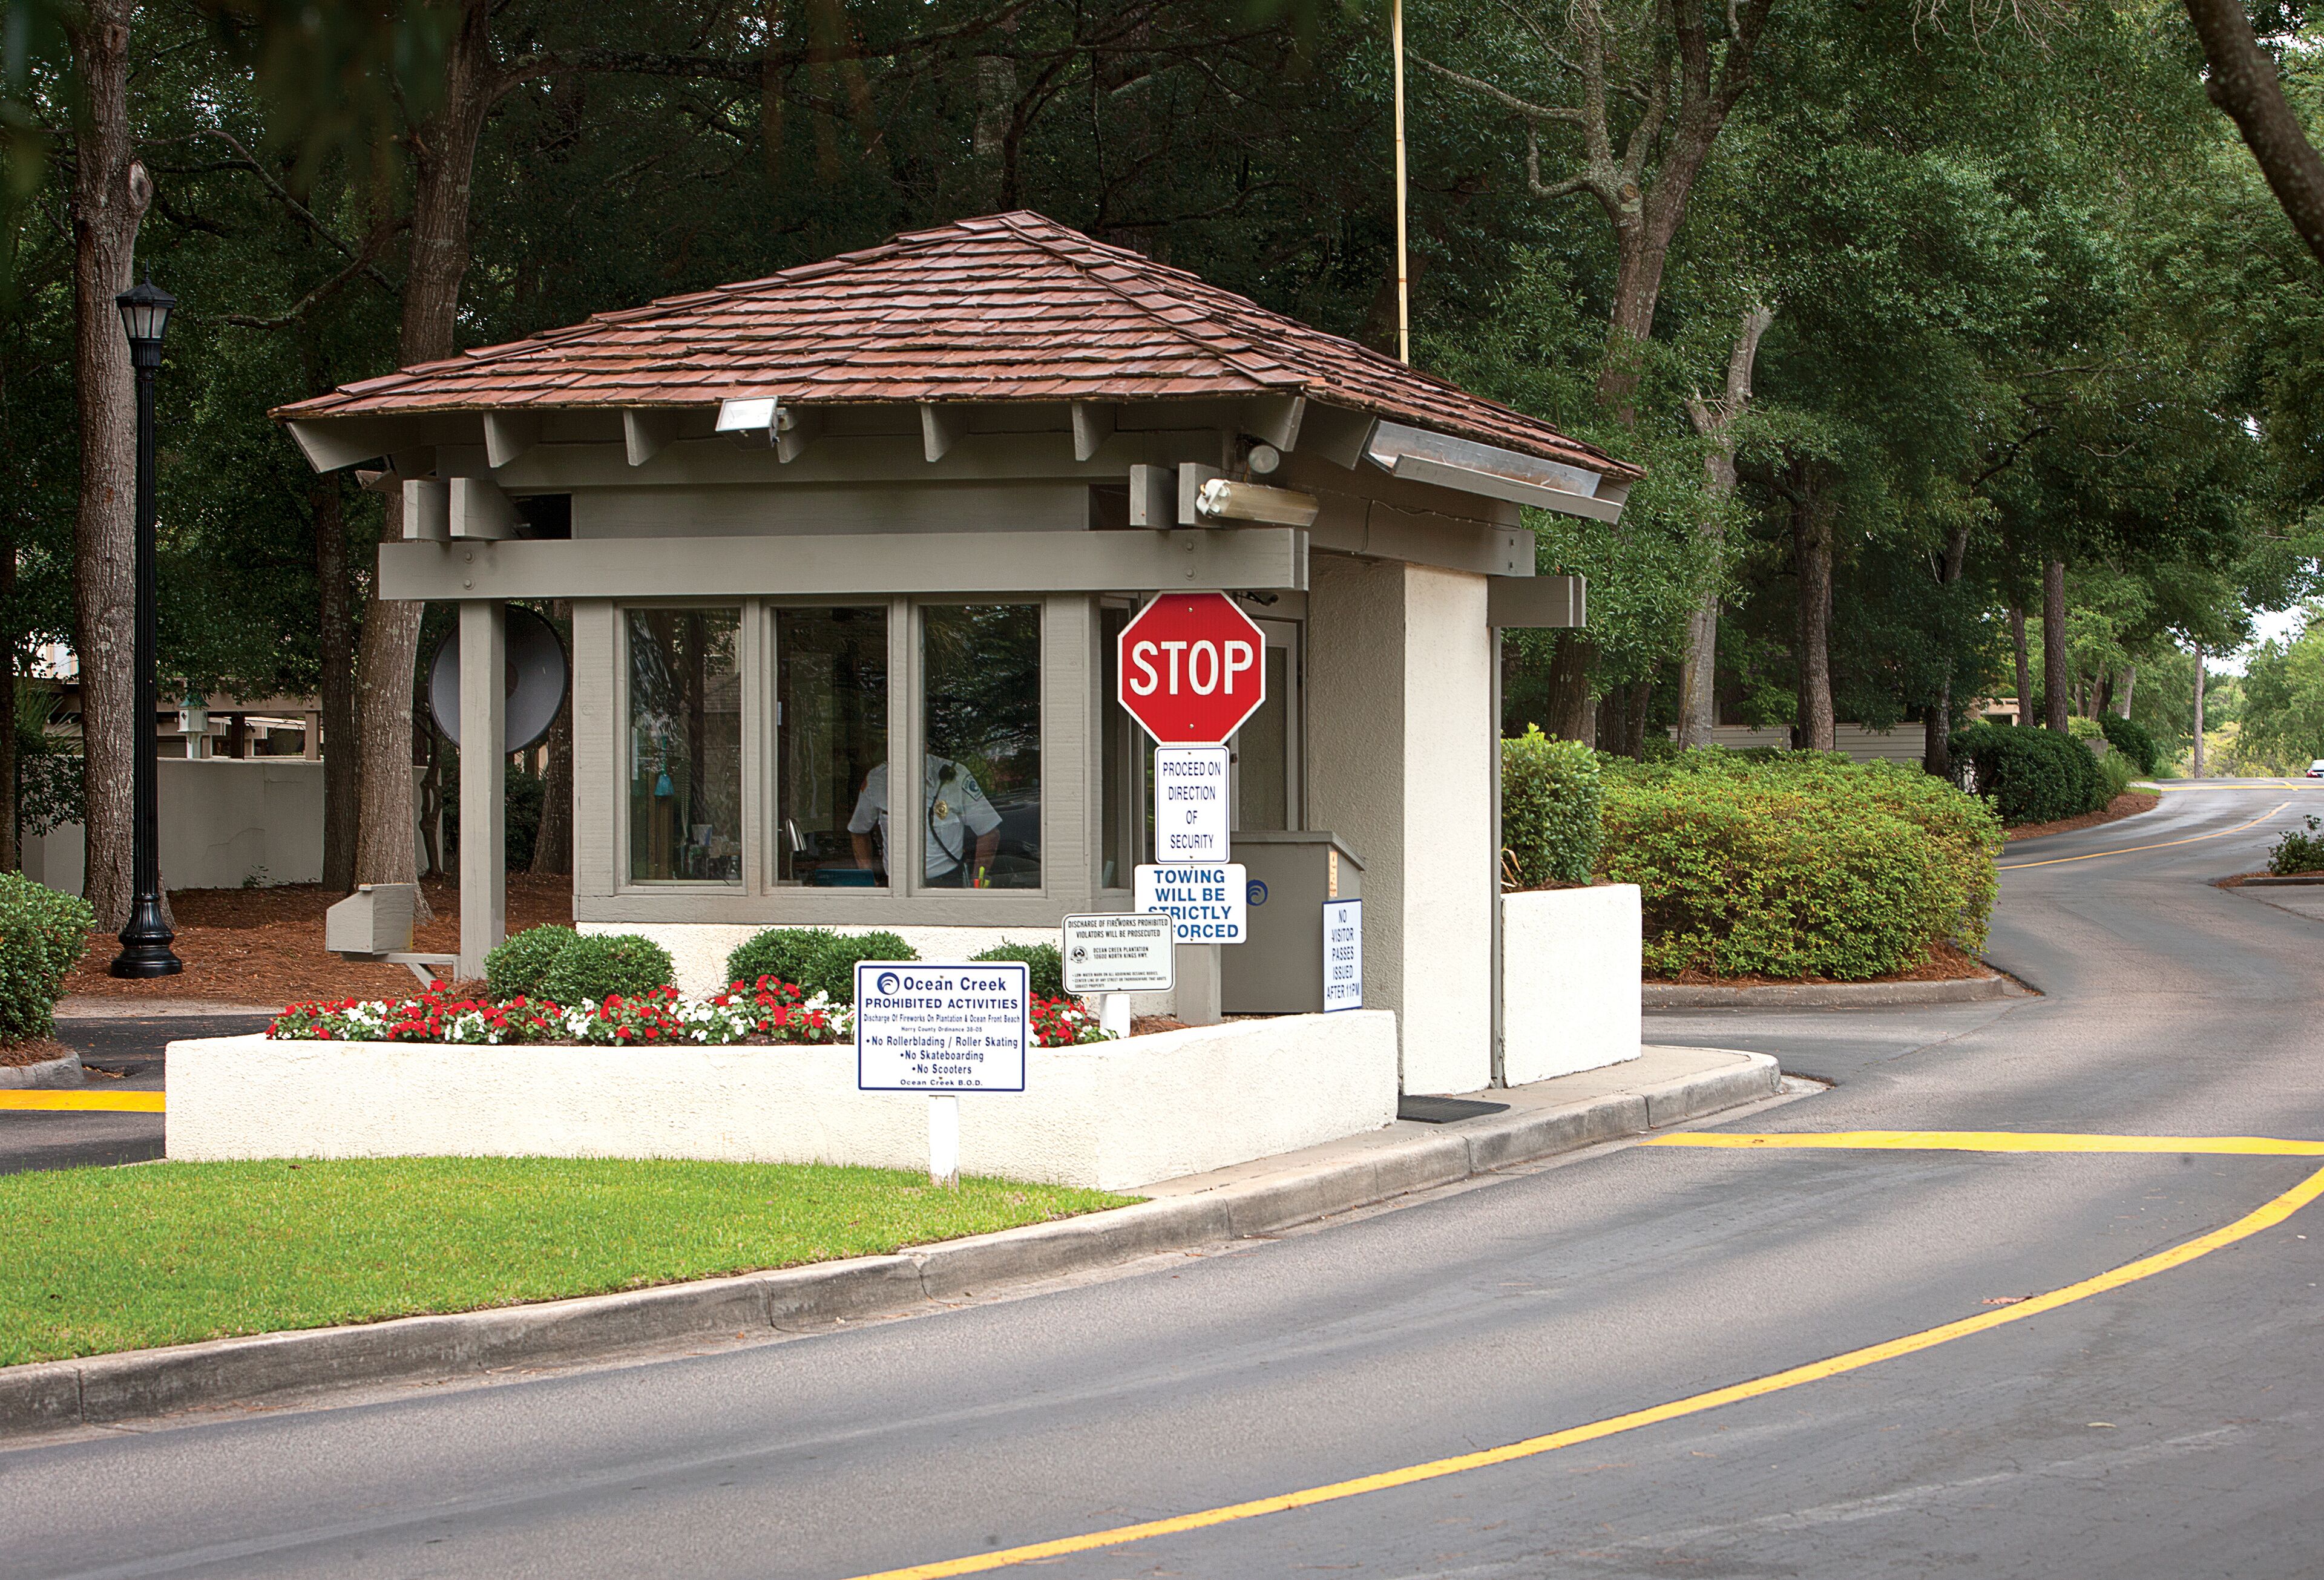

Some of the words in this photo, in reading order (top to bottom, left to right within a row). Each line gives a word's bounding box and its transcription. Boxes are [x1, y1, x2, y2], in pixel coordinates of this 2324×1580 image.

[1129, 640, 1253, 695] STOP
[1163, 762, 1205, 776] PROCEED
[1208, 762, 1221, 776] ON
[1168, 786, 1215, 801] DIRECTION
[1186, 810, 1198, 824] OF
[1170, 834, 1213, 849] SECURITY
[1154, 870, 1225, 883] TOWING
[1155, 888, 1196, 902] WILL
[1203, 888, 1225, 901] BE
[1339, 910, 1347, 923] NO
[1076, 930, 1104, 939] VIOLATORS
[1173, 924, 1238, 938] ORCED
[1332, 928, 1354, 943] VISITOR
[1332, 946, 1354, 962] PASSES
[1333, 965, 1353, 980] ISSUED
[904, 977, 953, 991] Ocean
[960, 977, 1006, 991] Creek
[1327, 985, 1344, 1000] AFTER
[1346, 982, 1359, 997] 11PM
[865, 998, 942, 1008] PROHIBITED
[948, 998, 1018, 1009] ACTIVITIES
[864, 1014, 890, 1023] Discharge
[899, 1014, 925, 1022] Fireworks
[936, 1014, 962, 1023] Plantation
[988, 1014, 1002, 1023] Front
[872, 1036, 883, 1046] No
[887, 1036, 945, 1048] Rollerblading
[948, 1037, 952, 1048] /
[956, 1037, 982, 1047] Roller
[985, 1037, 1018, 1048] Skating
[905, 1050, 916, 1060] No
[920, 1050, 984, 1063] Skateboarding
[917, 1064, 928, 1074] No
[932, 1064, 972, 1074] Scooters
